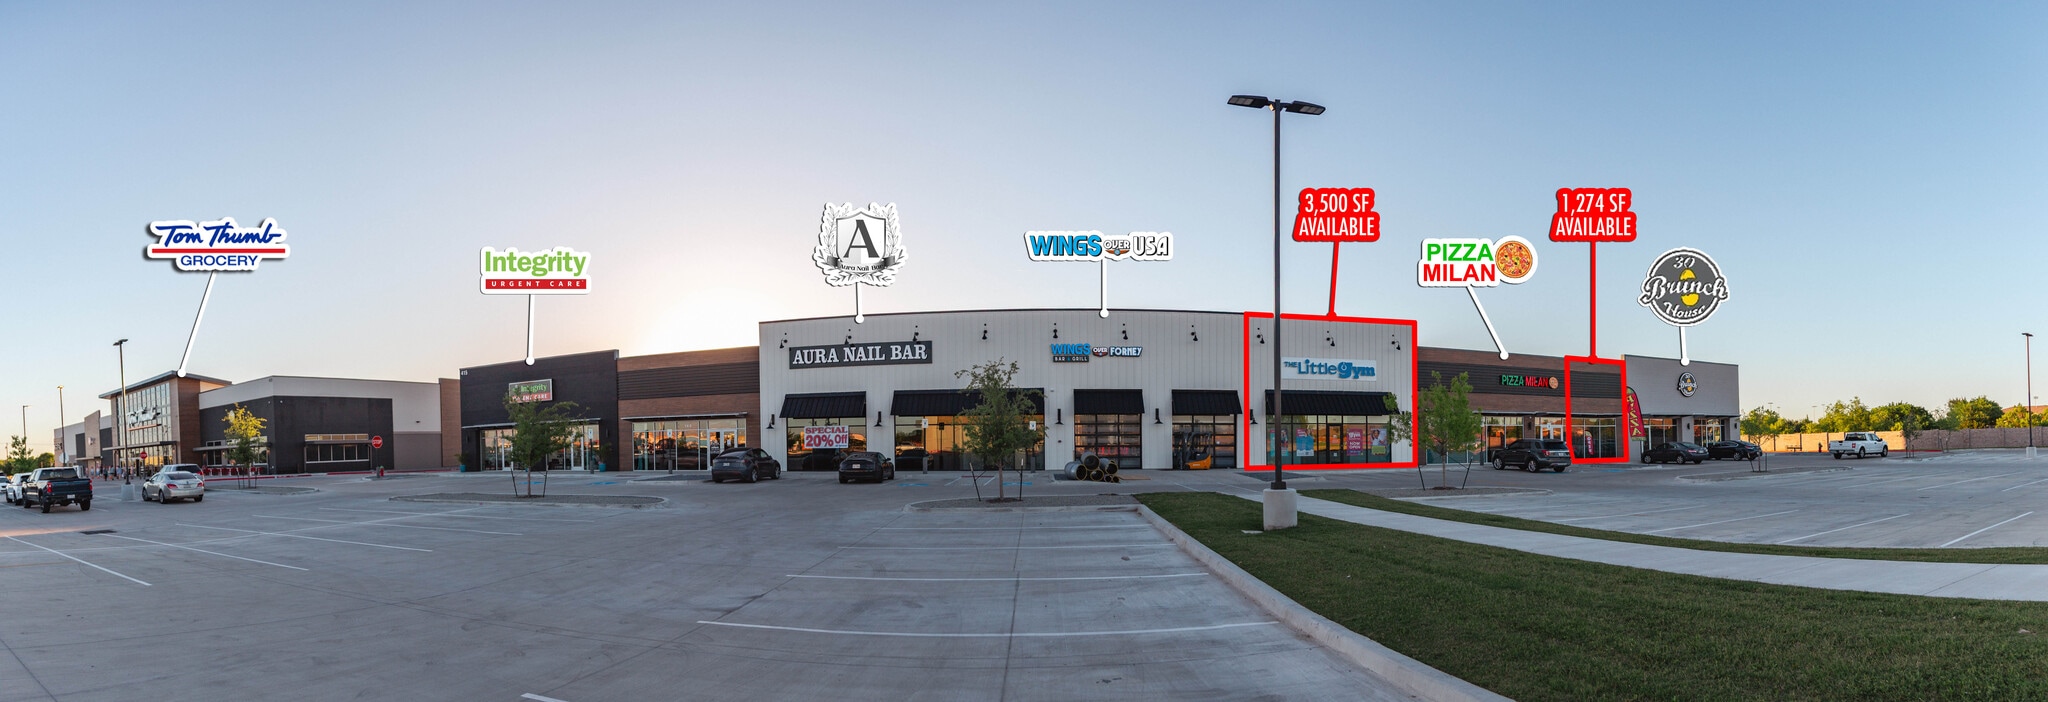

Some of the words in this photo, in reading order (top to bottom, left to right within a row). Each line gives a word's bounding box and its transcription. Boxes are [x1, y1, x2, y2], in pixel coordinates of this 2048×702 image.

[793, 348, 839, 364] AURA
[843, 345, 885, 362] NAIL
[890, 344, 927, 360] BAR
[1051, 343, 1091, 355] WINGS
[1110, 346, 1143, 356] FORNEY
[1297, 359, 1337, 374] Little
[1338, 361, 1375, 379] gym
[1501, 374, 1524, 386] PIZZA
[1525, 375, 1549, 387] MILAN
[805, 426, 848, 434] SPECIAL
[805, 434, 834, 447] 20%
[834, 433, 848, 444] Off
